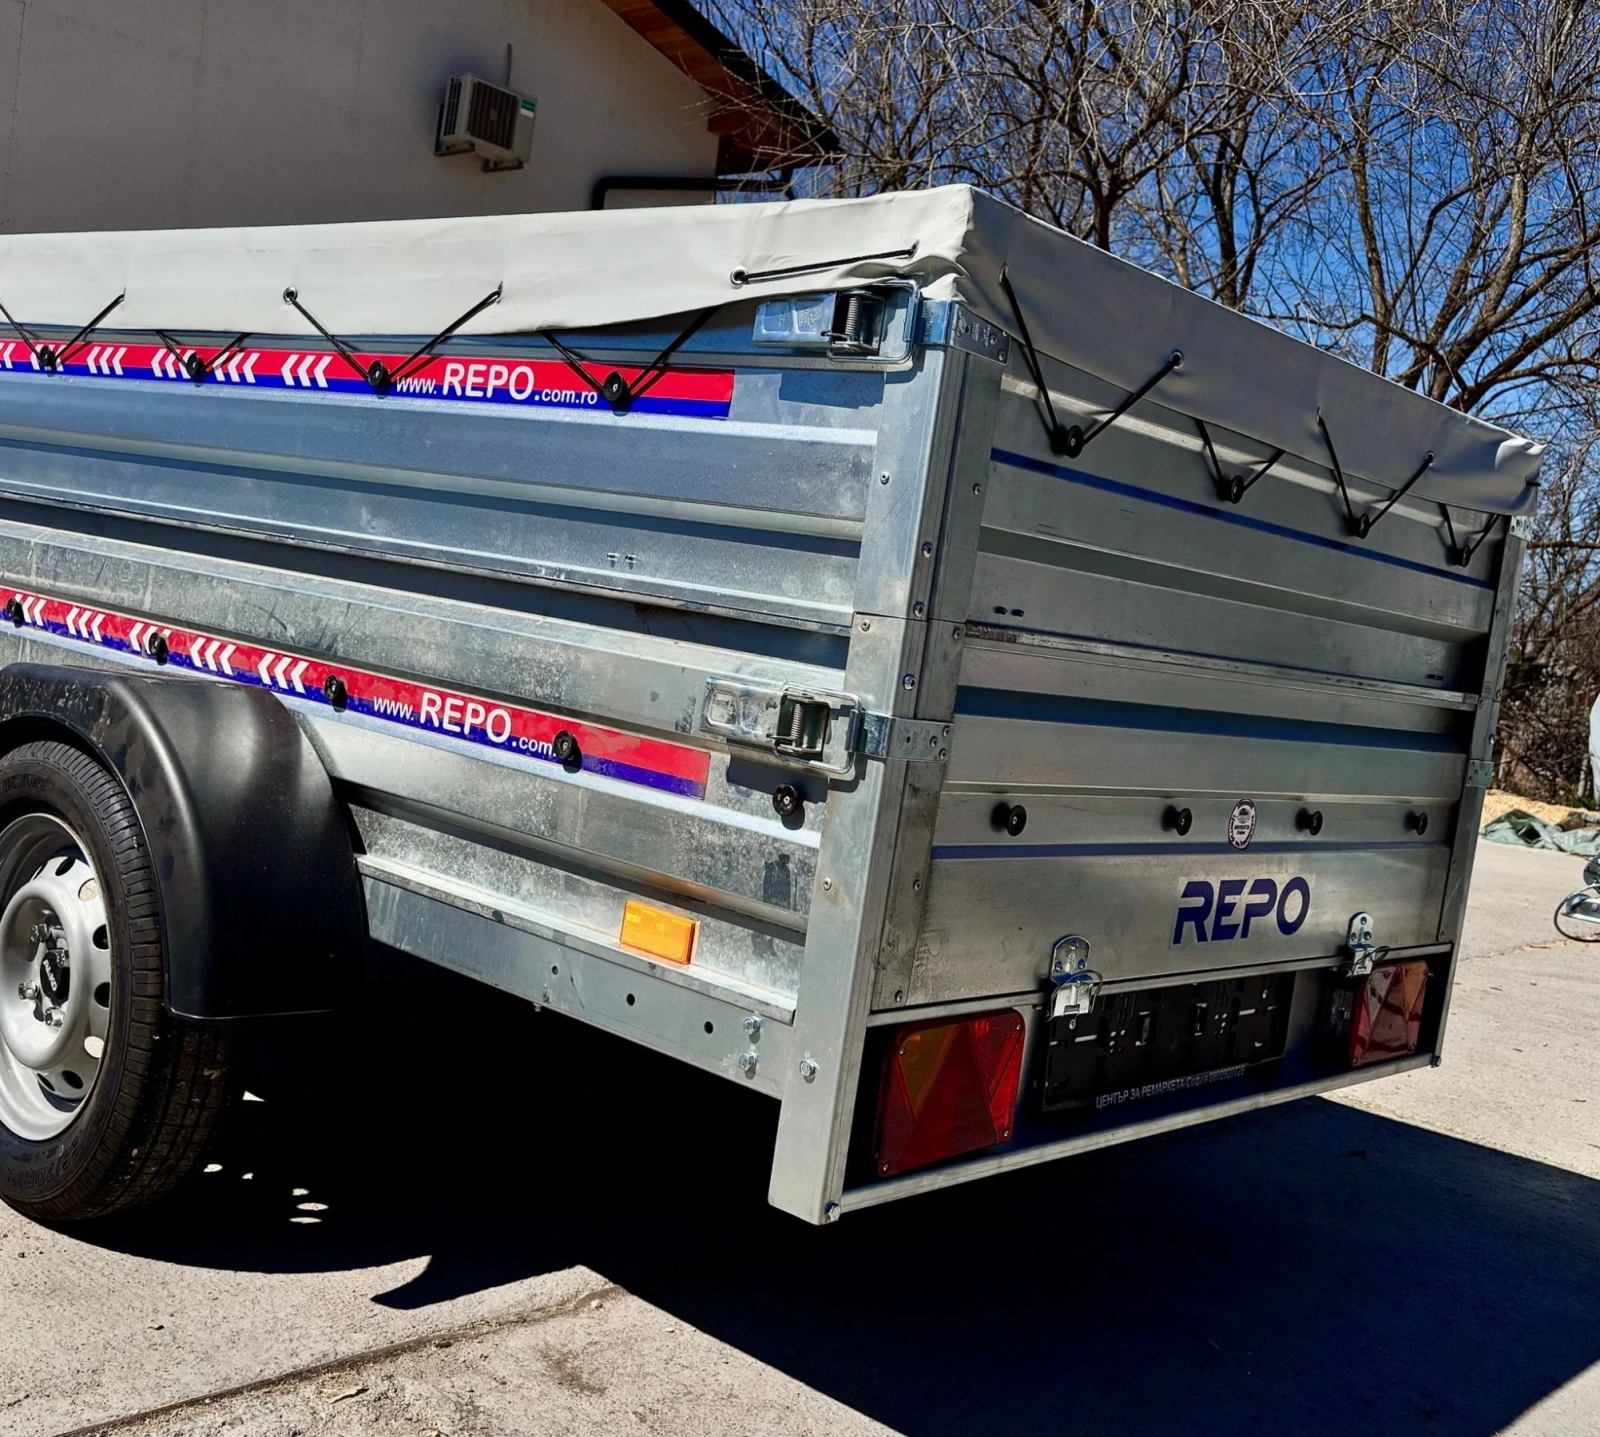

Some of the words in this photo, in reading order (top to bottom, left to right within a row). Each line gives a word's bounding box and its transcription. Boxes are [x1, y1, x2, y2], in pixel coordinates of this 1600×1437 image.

[373, 693, 557, 757] www.REPO.com.
[1173, 876, 1311, 945] REPO
[1096, 1090, 1130, 1110] ЦЕНТЪР
[1130, 1087, 1141, 1101] ЗА
